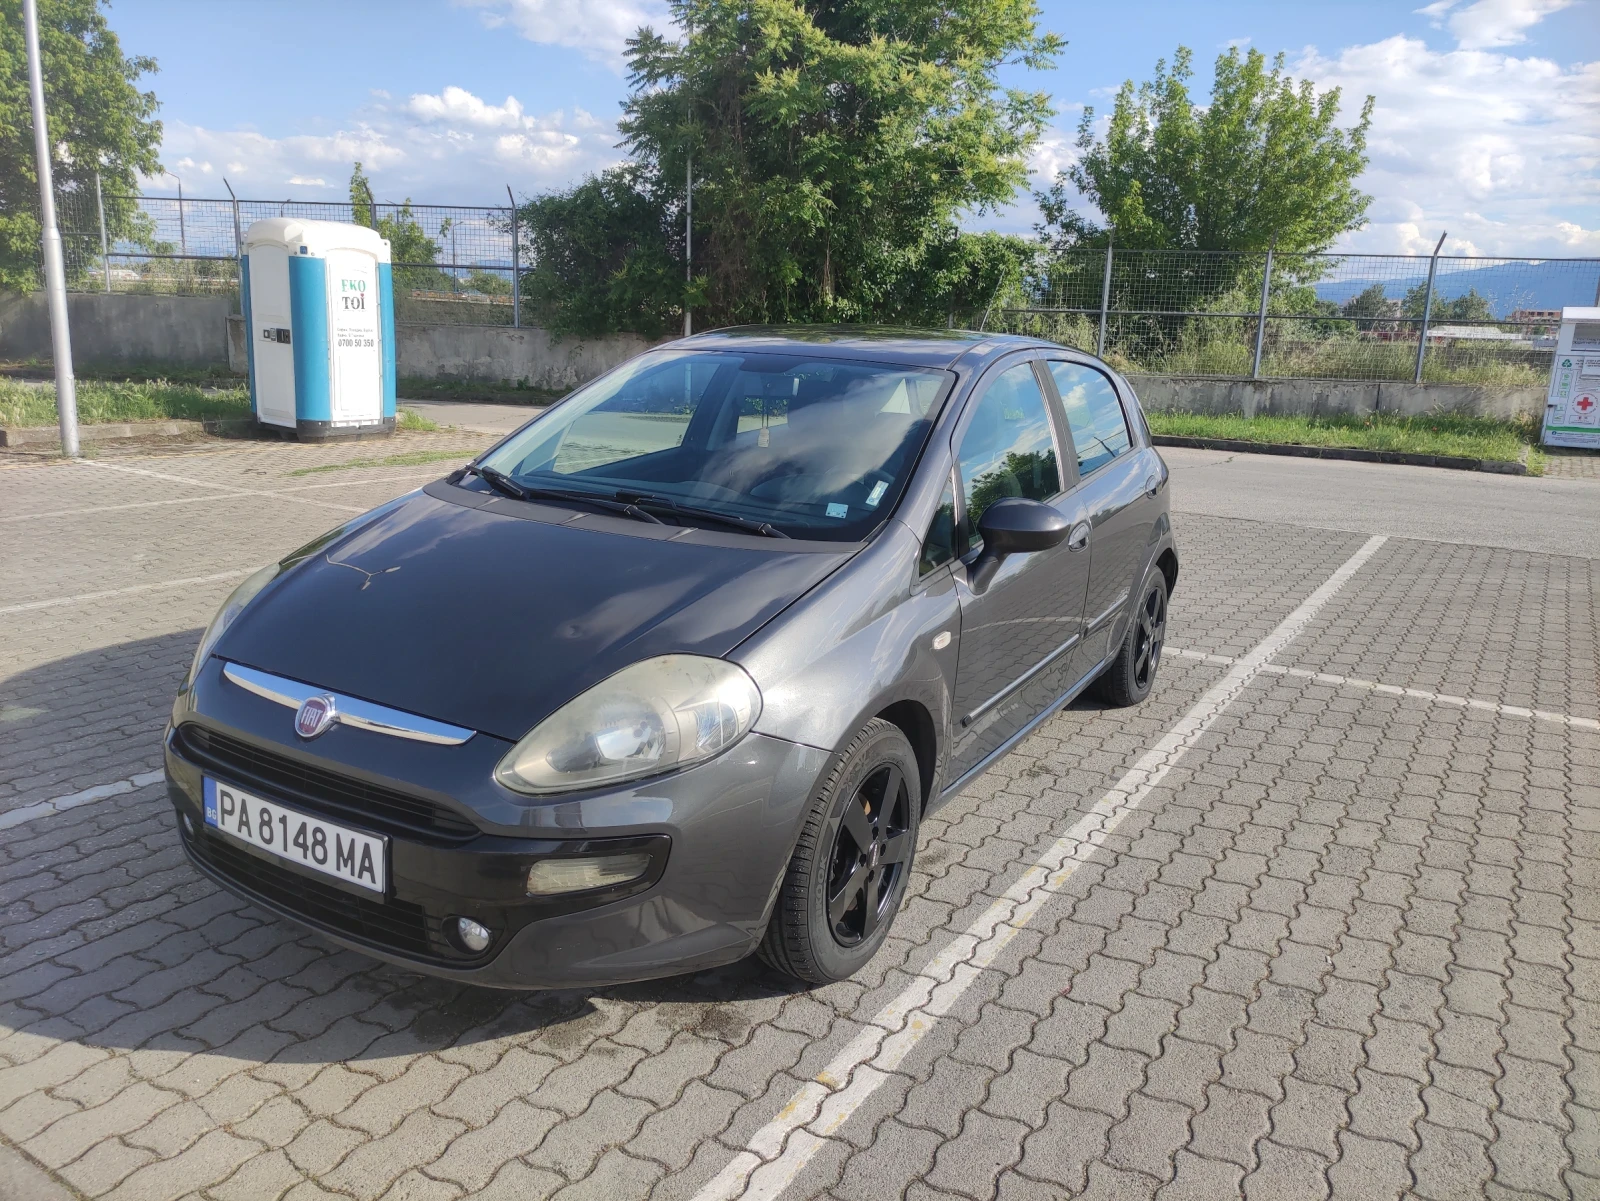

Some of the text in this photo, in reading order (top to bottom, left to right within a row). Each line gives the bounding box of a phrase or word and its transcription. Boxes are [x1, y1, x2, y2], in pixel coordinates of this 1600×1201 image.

[341, 279, 366, 292] EKO
[338, 339, 374, 347] 0700 50 350
[301, 706, 323, 727] FIAT
[206, 807, 216, 820] BG
[220, 789, 376, 884] PA 8148 MA
